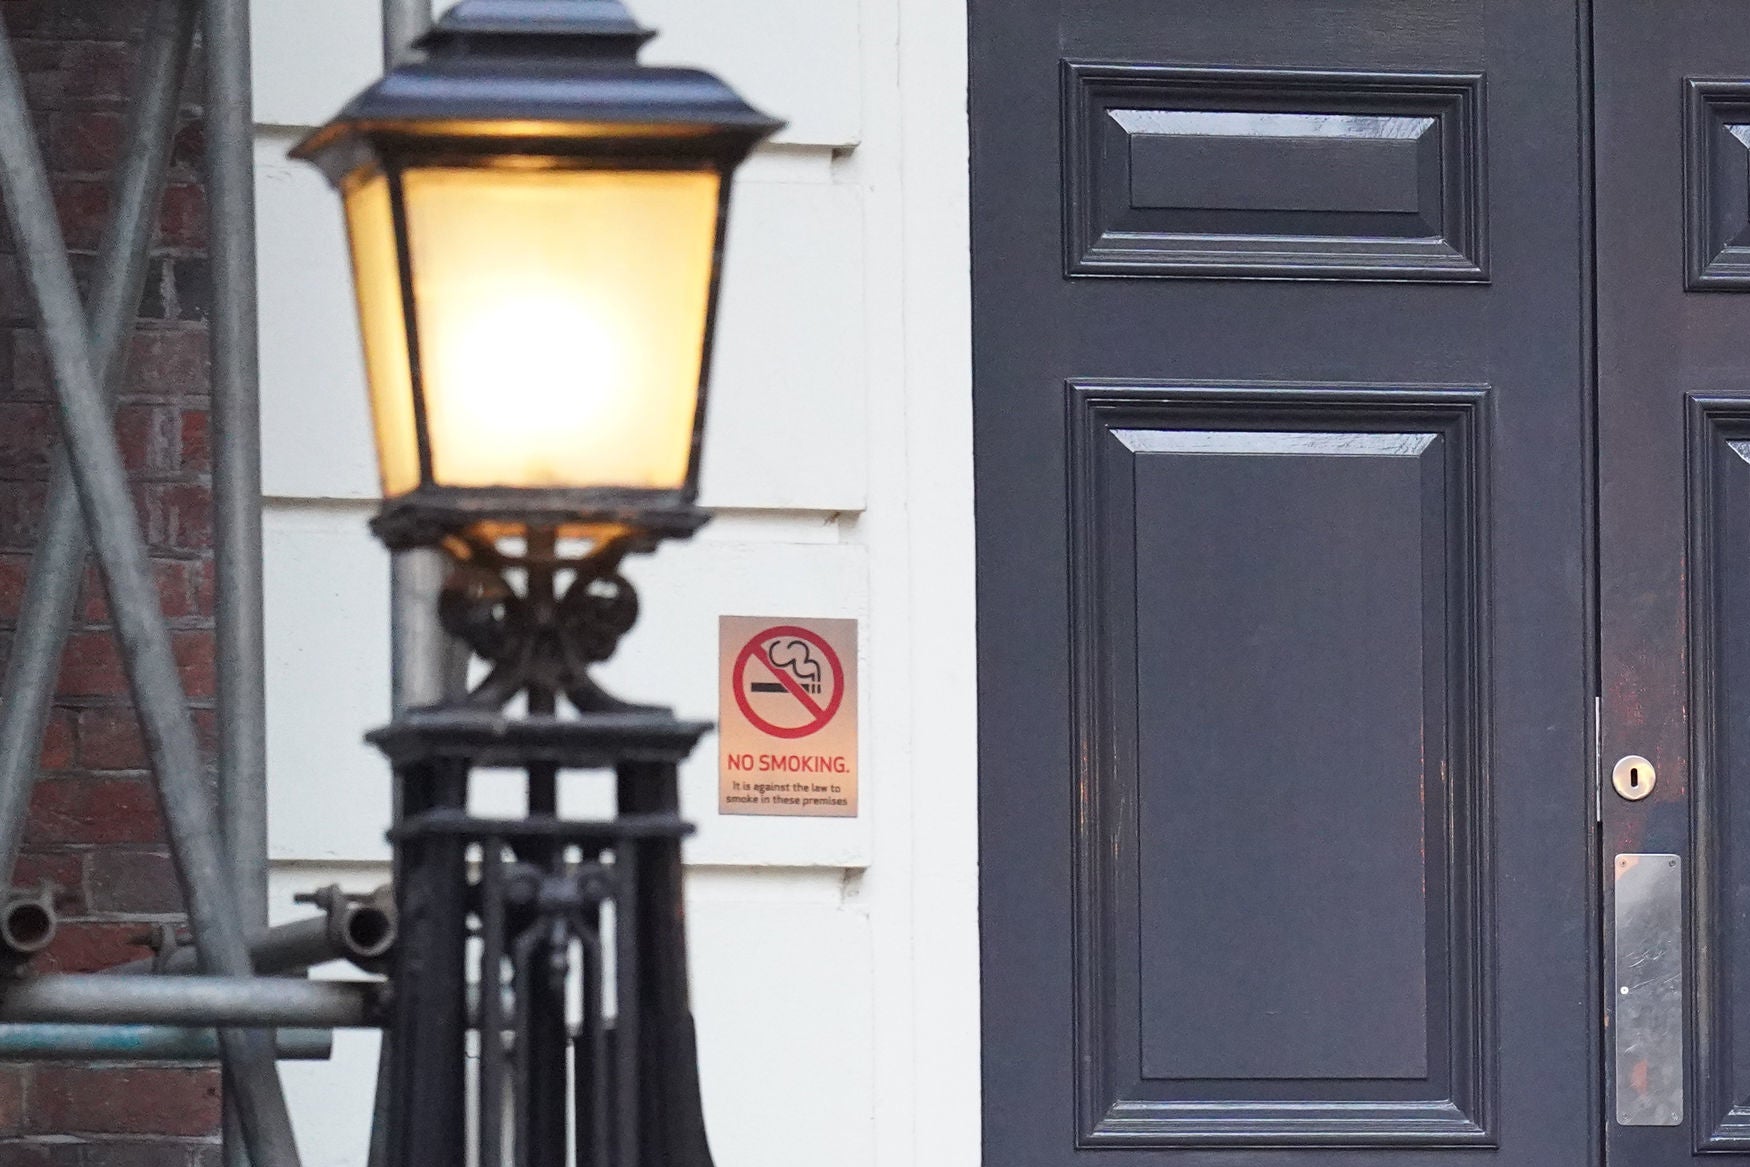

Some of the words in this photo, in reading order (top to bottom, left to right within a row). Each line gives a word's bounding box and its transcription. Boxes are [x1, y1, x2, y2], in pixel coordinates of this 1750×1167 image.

[727, 753, 754, 772] NO
[758, 754, 851, 773] SMOKING.
[732, 780, 740, 790] It
[743, 781, 750, 791] is
[753, 781, 790, 794] against
[792, 782, 809, 792] the
[811, 782, 828, 793] law
[830, 784, 841, 793] to
[726, 795, 758, 804] smoke
[760, 795, 770, 804] in
[772, 795, 800, 805] these
[802, 796, 848, 807] premises
